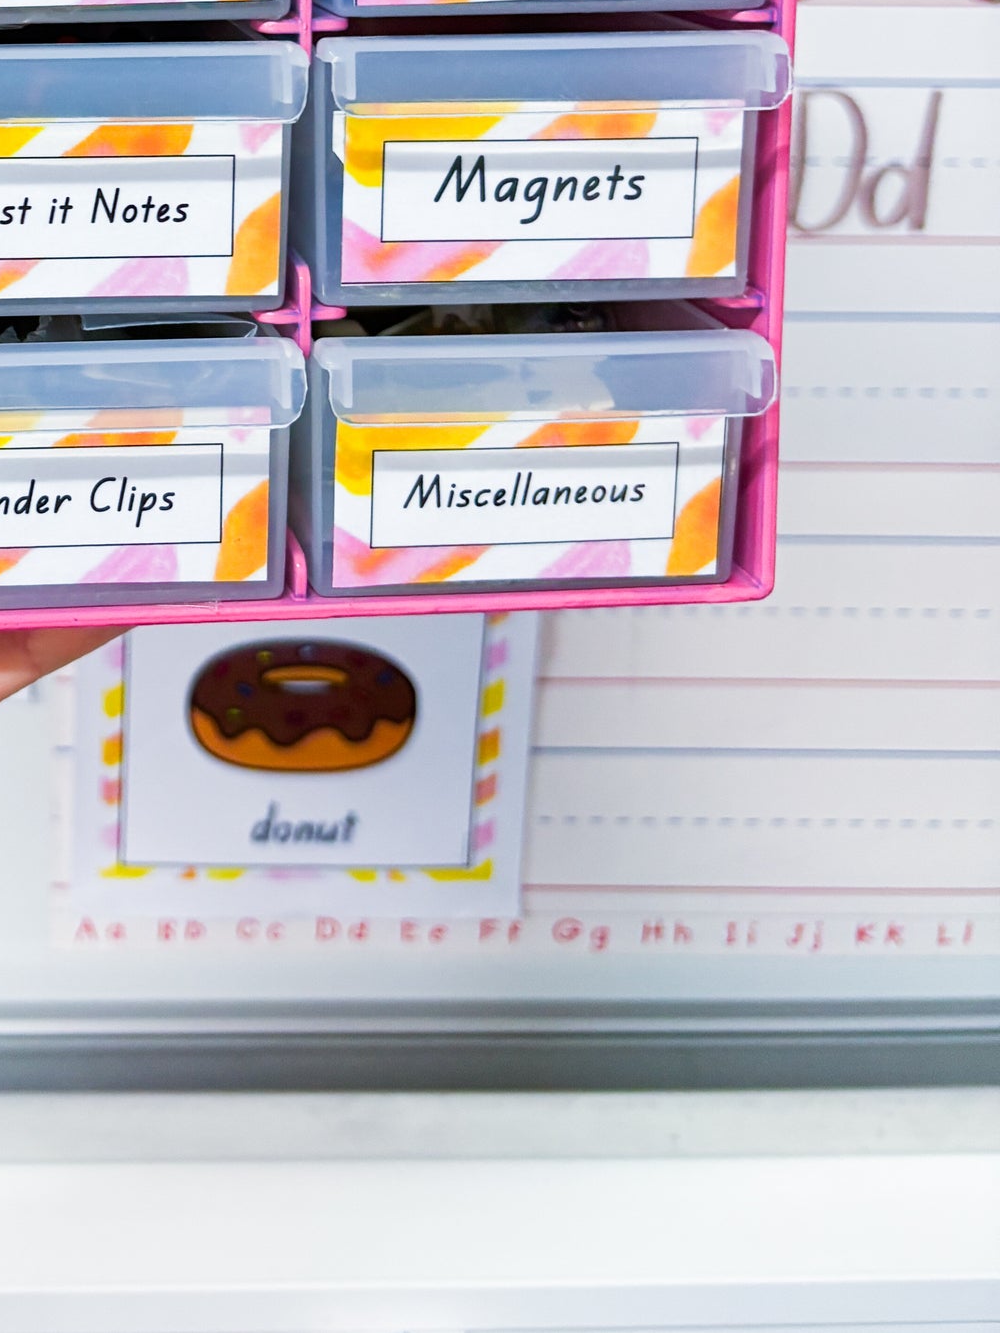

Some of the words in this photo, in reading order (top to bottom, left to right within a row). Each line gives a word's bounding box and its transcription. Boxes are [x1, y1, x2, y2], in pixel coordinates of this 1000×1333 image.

[48, 196, 74, 225] it
[90, 187, 190, 224] Notes
[433, 154, 646, 225] Magnets
[89, 476, 176, 528] Clips
[403, 471, 646, 509] Miscellaneous
[250, 801, 360, 847] donut
